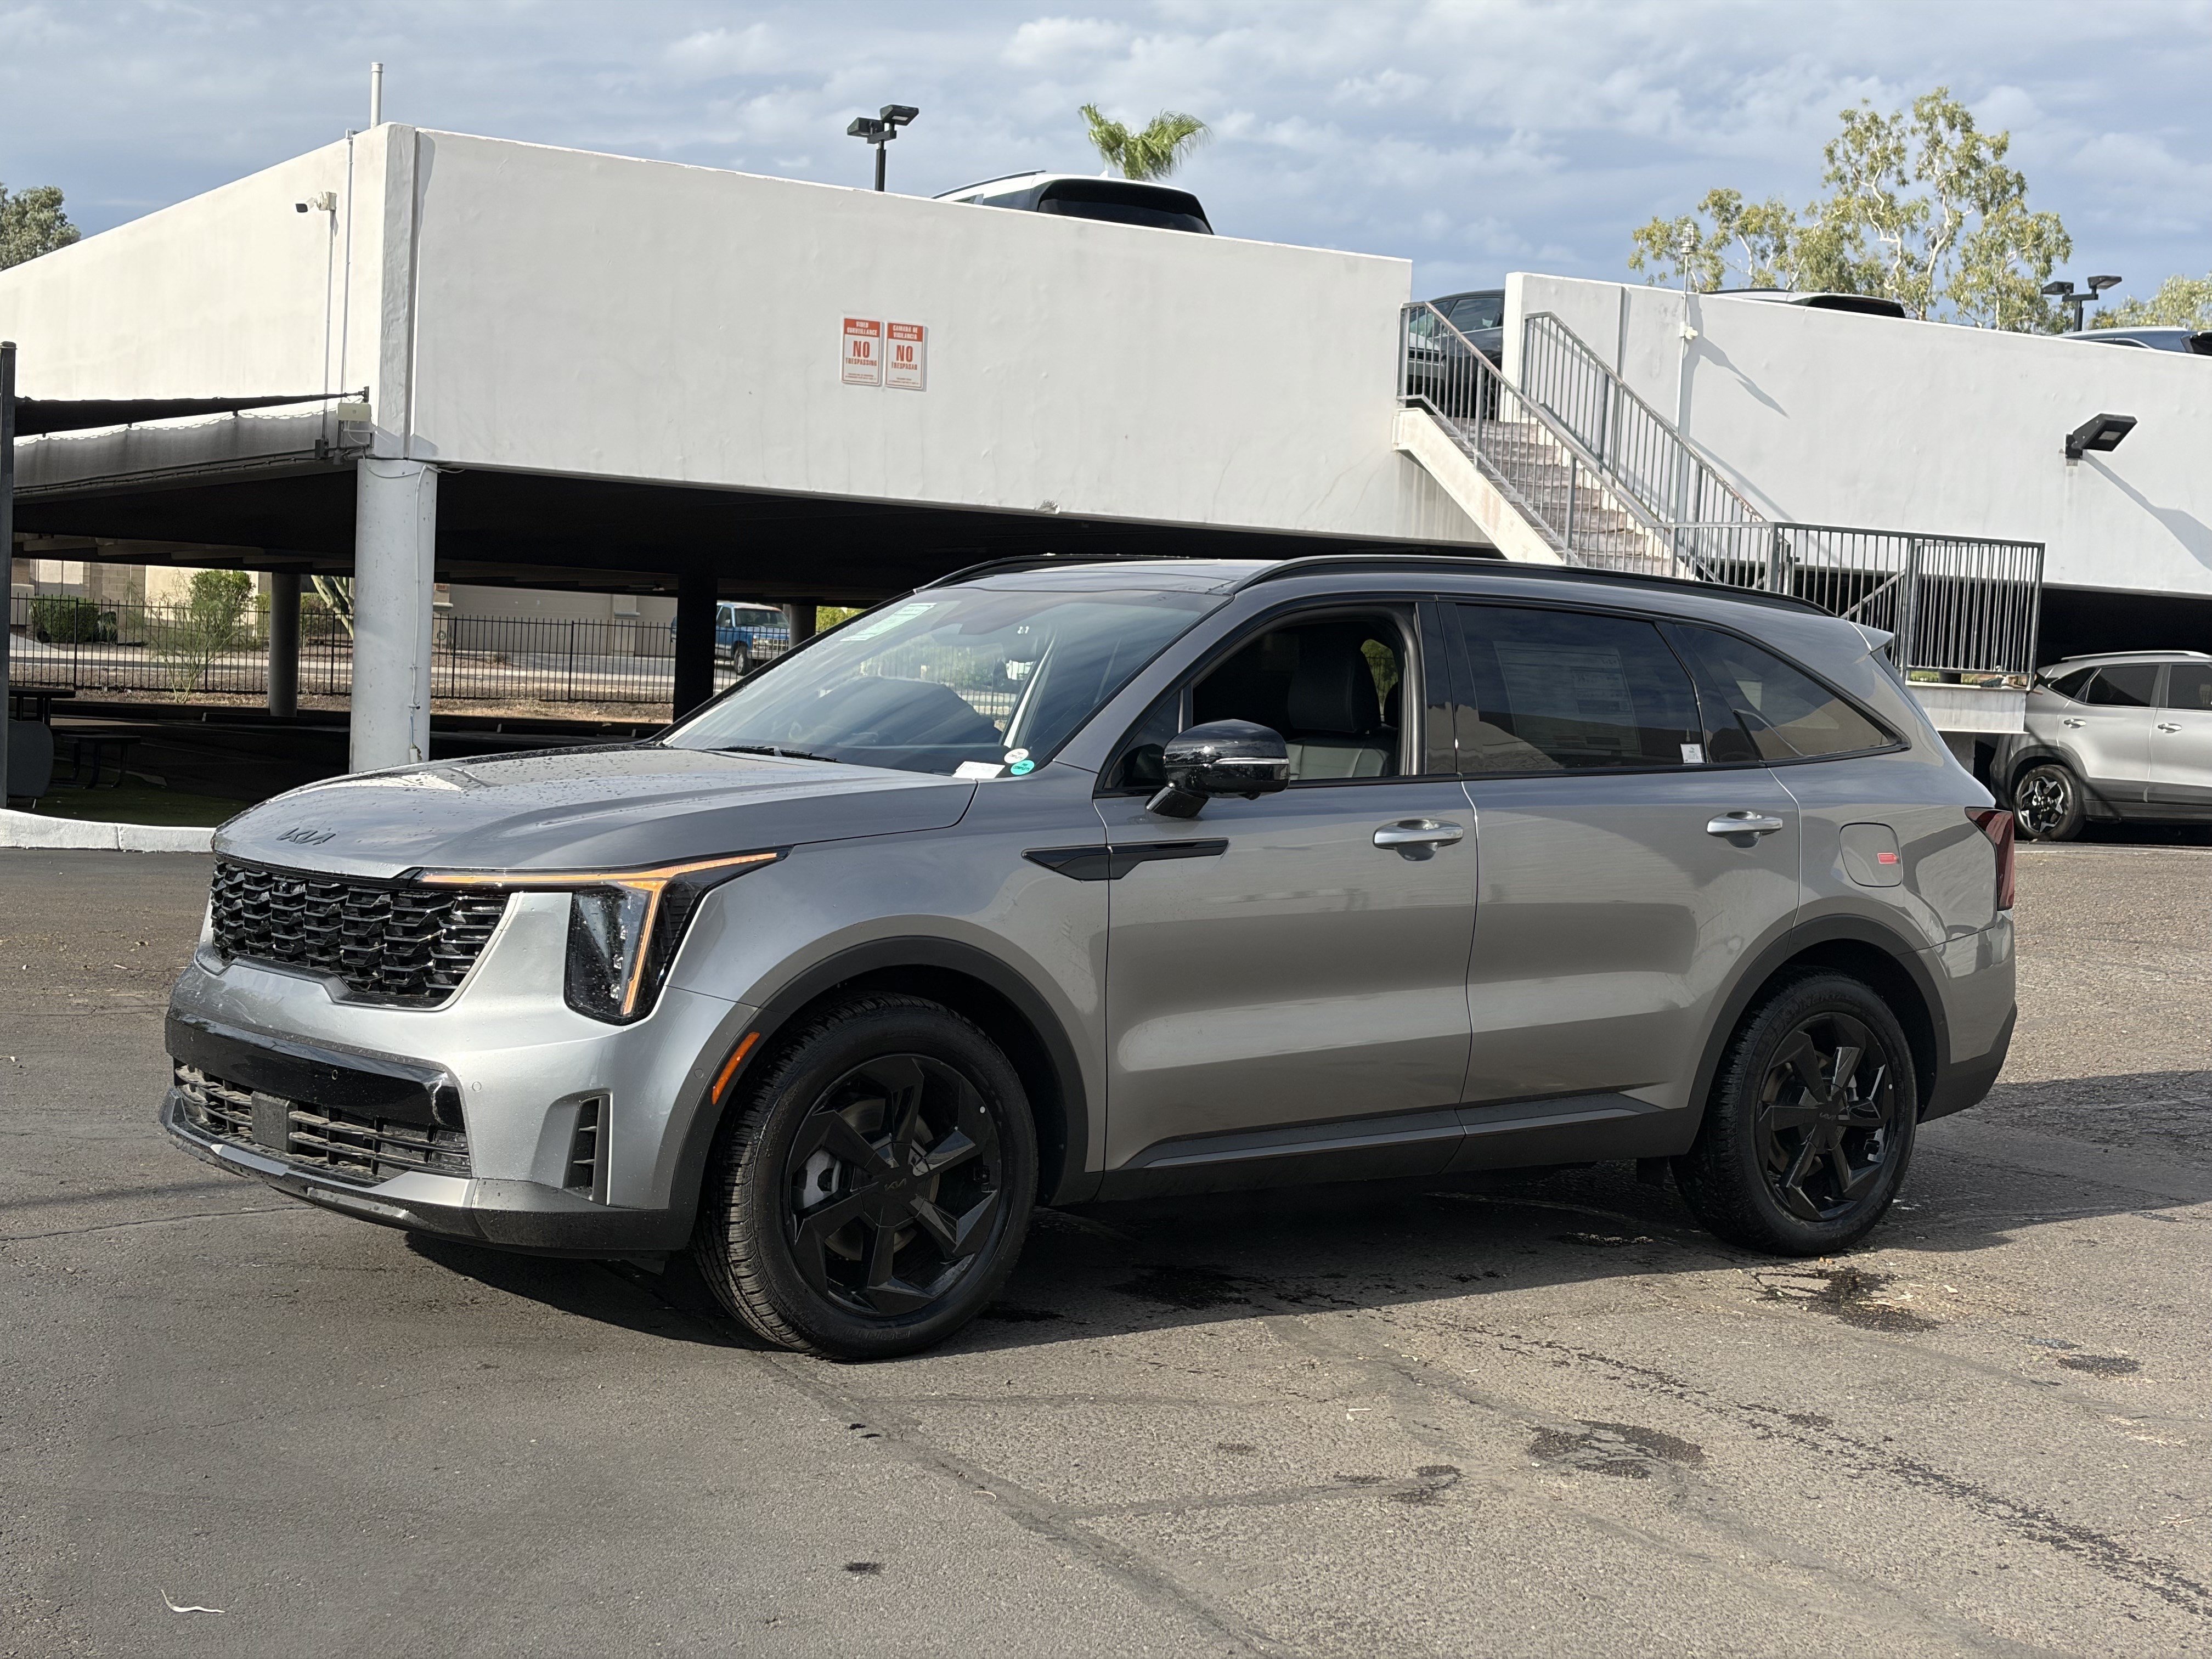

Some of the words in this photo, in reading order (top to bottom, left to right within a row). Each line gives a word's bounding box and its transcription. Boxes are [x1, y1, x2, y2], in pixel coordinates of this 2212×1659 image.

[847, 327, 877, 336] SURVEILLANCE
[853, 341, 870, 358] NO
[896, 345, 913, 362] NO
[845, 357, 877, 366] TRESPASSING
[891, 362, 918, 370] TRESPASAR
[276, 827, 336, 845] KIA
